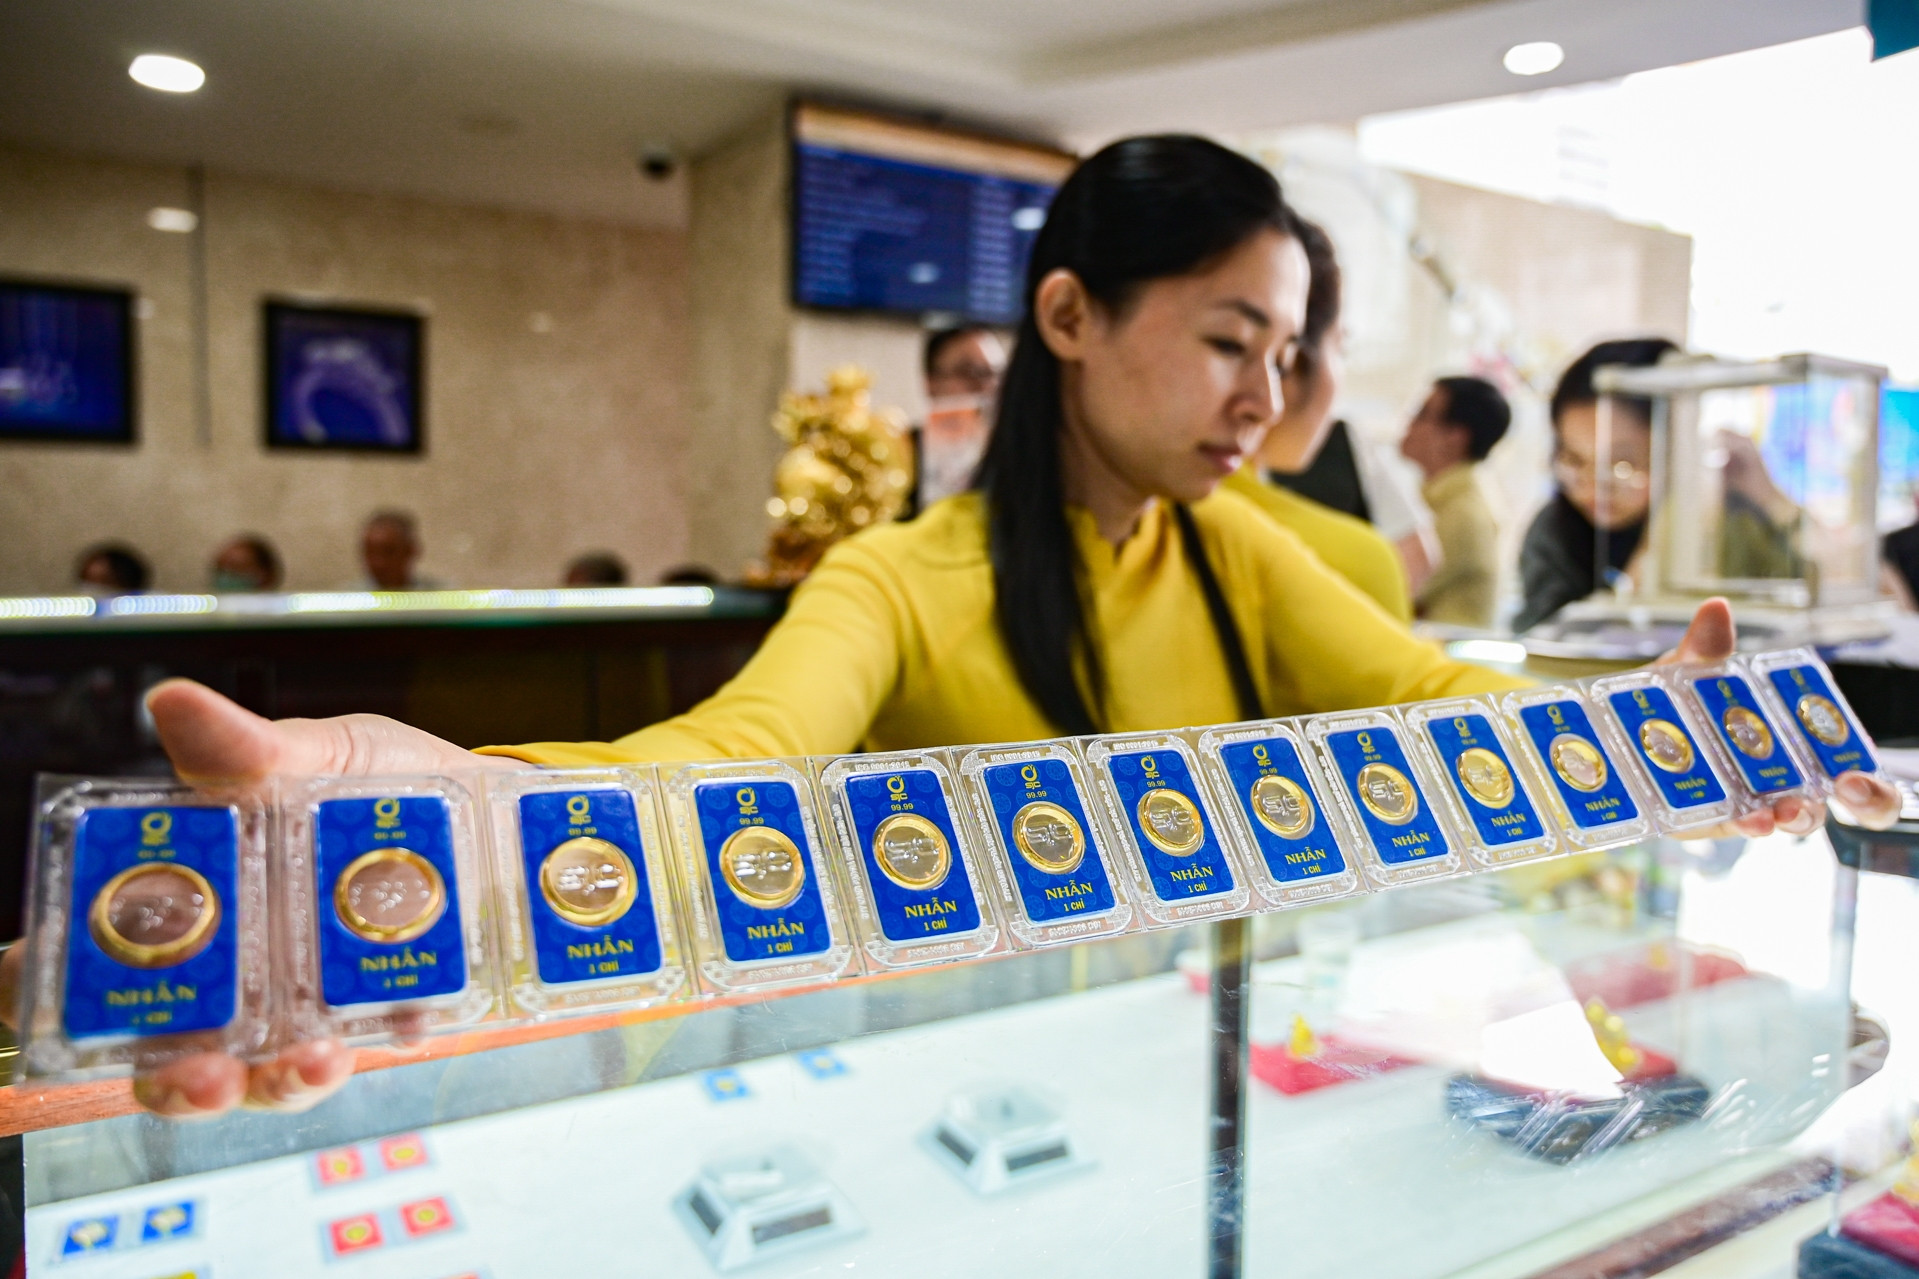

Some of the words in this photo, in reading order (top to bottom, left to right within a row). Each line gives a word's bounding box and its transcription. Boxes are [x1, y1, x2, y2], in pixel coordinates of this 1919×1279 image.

[1025, 780, 1043, 790] SJC
[1147, 780, 1167, 788] 99.99
[1025, 790, 1047, 799] 99.99
[890, 802, 915, 811] 99.99
[739, 817, 765, 826] 99.99
[1390, 830, 1431, 847] NHẪN
[1285, 846, 1326, 864] NHẪN
[1169, 863, 1214, 881] NHẪN
[1309, 862, 1323, 874] CHỈ
[1045, 879, 1093, 901] NHẪN
[1195, 880, 1209, 892] CHỈ
[904, 896, 957, 919] NHẪN
[1071, 899, 1086, 912] CHỈ
[746, 917, 805, 940] NHẪN
[932, 916, 948, 931] CHỈ
[566, 933, 635, 960] NHẪN
[776, 940, 794, 953] CHỈ
